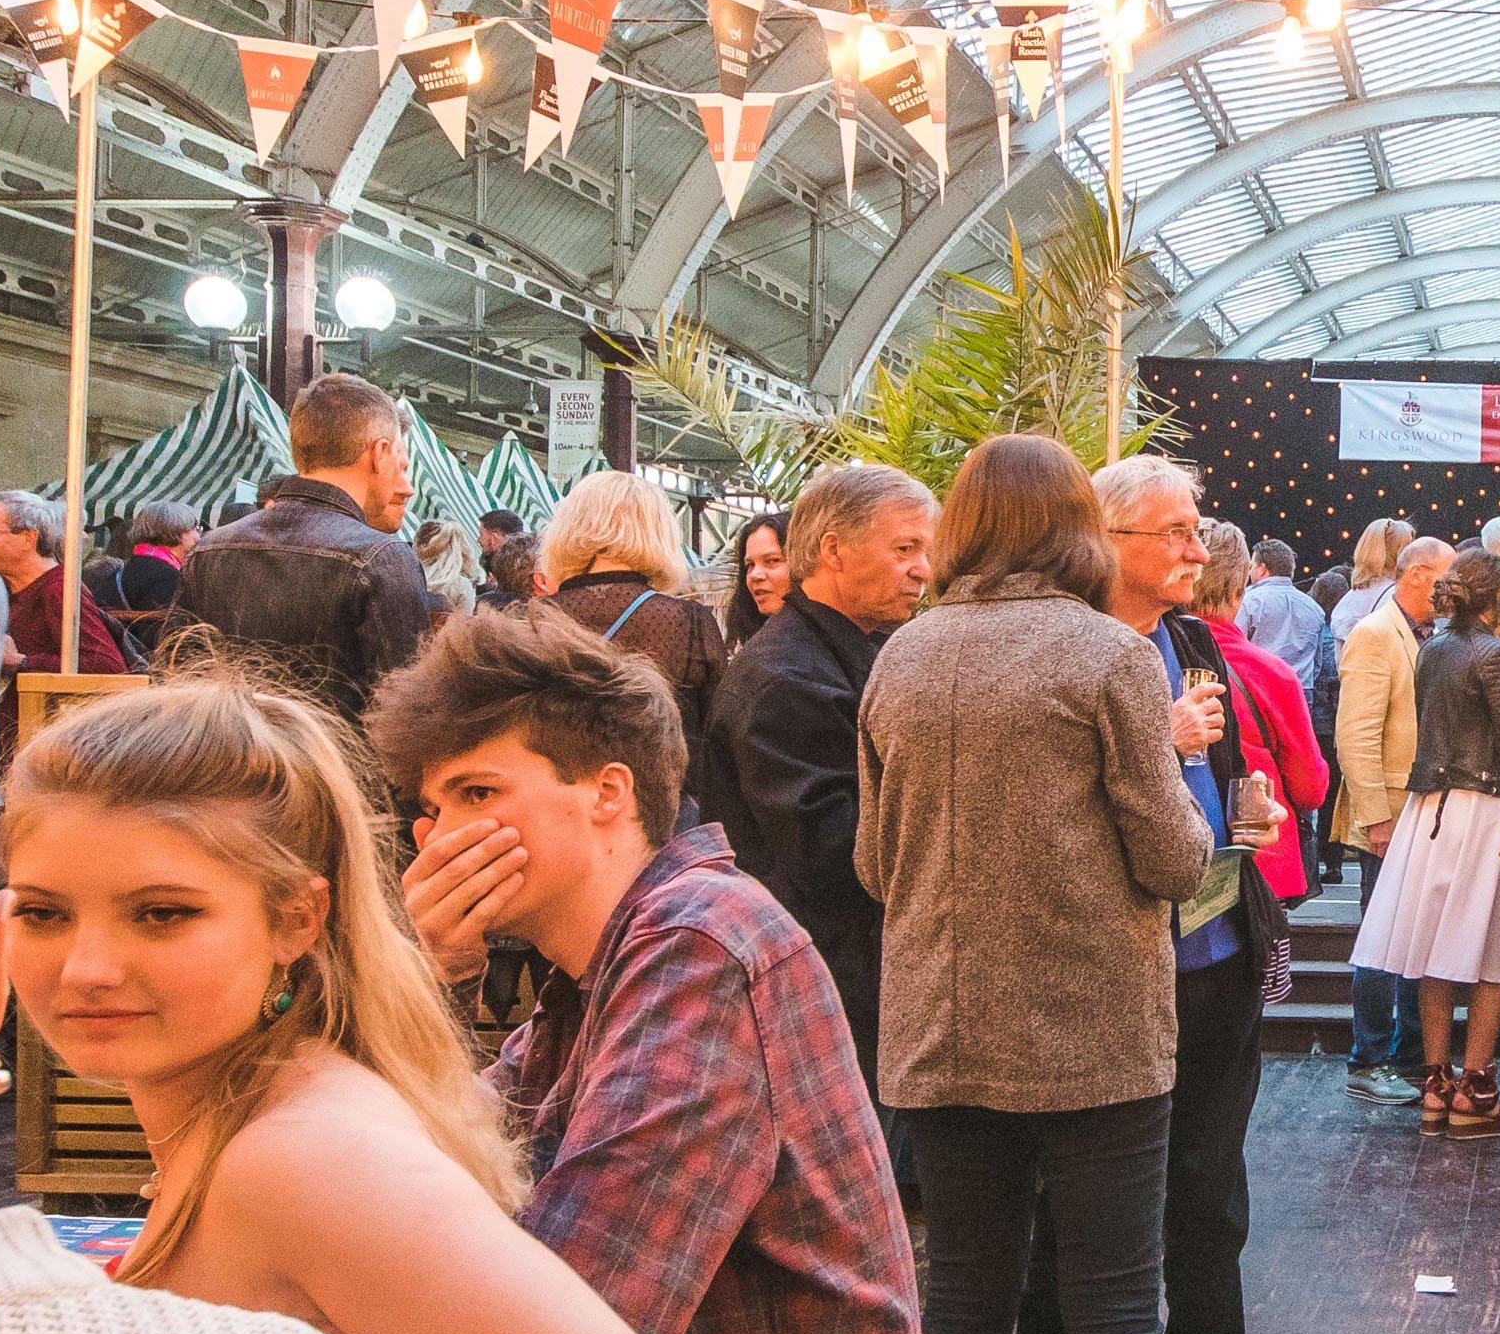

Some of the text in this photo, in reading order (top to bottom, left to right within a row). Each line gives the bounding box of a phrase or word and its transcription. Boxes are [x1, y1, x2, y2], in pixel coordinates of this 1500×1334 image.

[887, 91, 912, 106] GREEN
[561, 393, 591, 401] EVERY
[557, 402, 595, 410] SECOND
[556, 411, 595, 419] SUNDAY
[1359, 429, 1463, 442] KINGSWOOD
